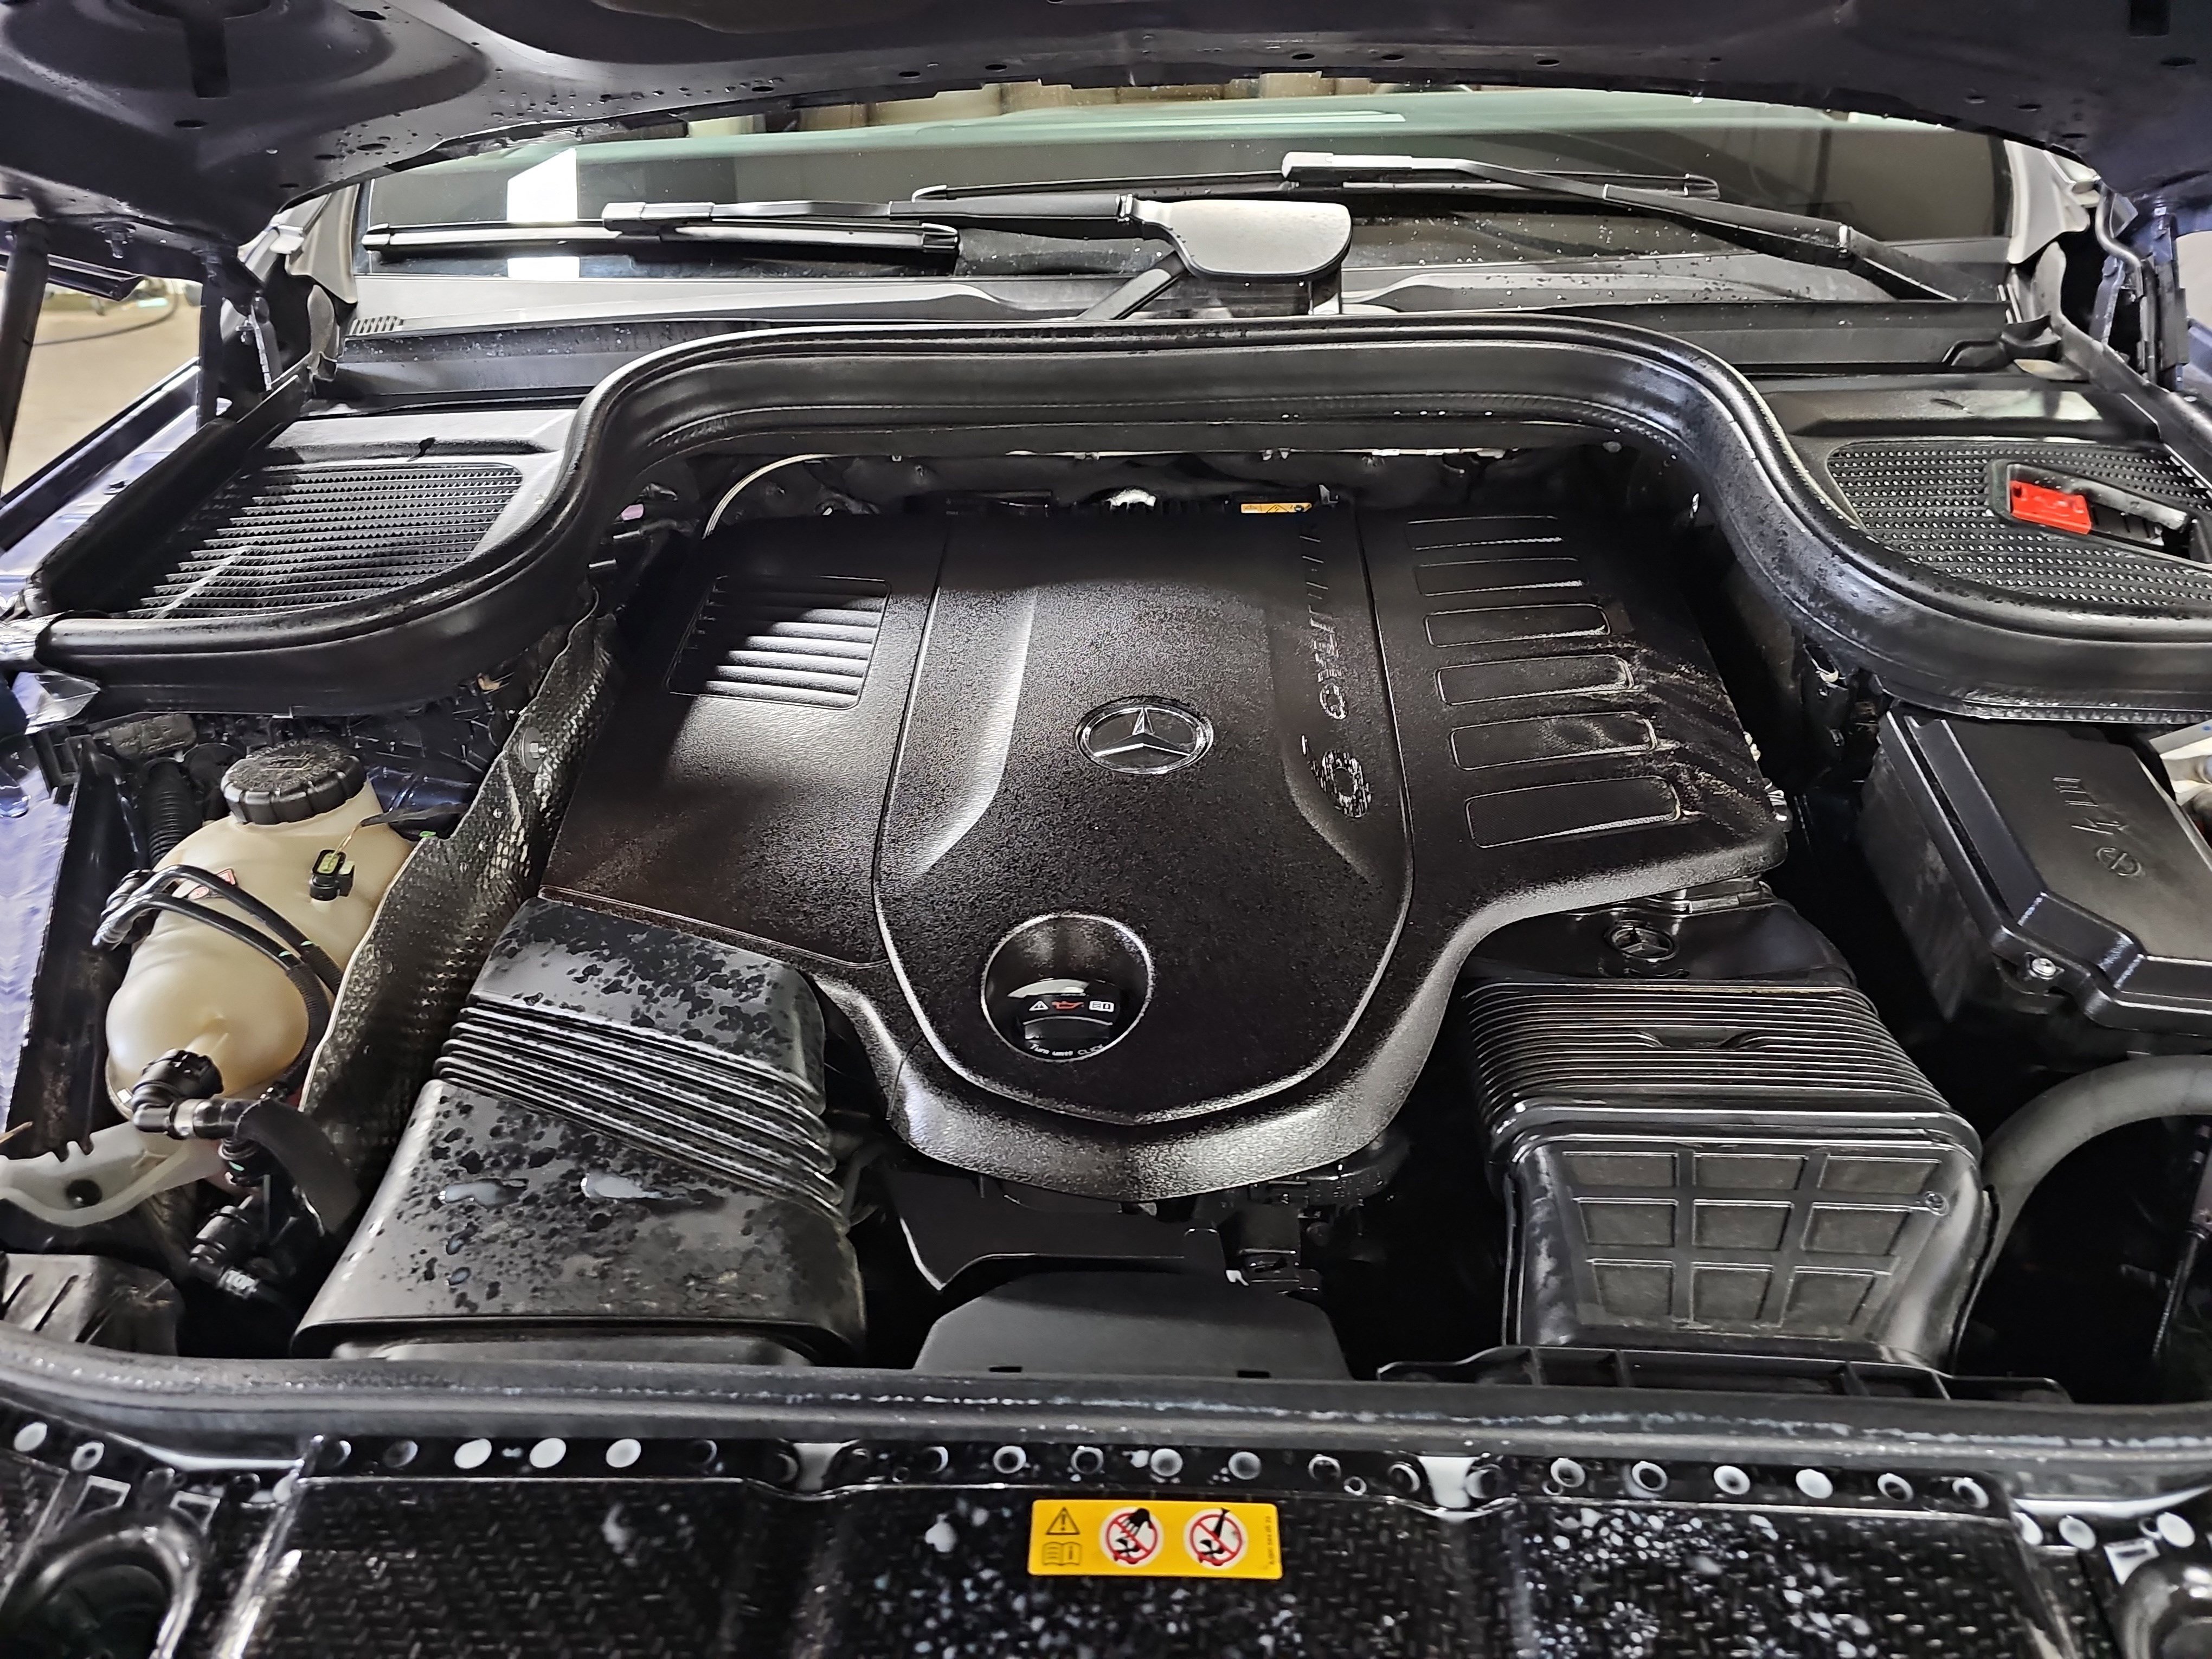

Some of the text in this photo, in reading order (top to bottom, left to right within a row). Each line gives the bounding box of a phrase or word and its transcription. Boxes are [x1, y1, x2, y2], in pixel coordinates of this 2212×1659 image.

[1301, 734, 1372, 818] 6
[1030, 1044, 1050, 1054] Turn
[1077, 1044, 1104, 1055] CLICK
